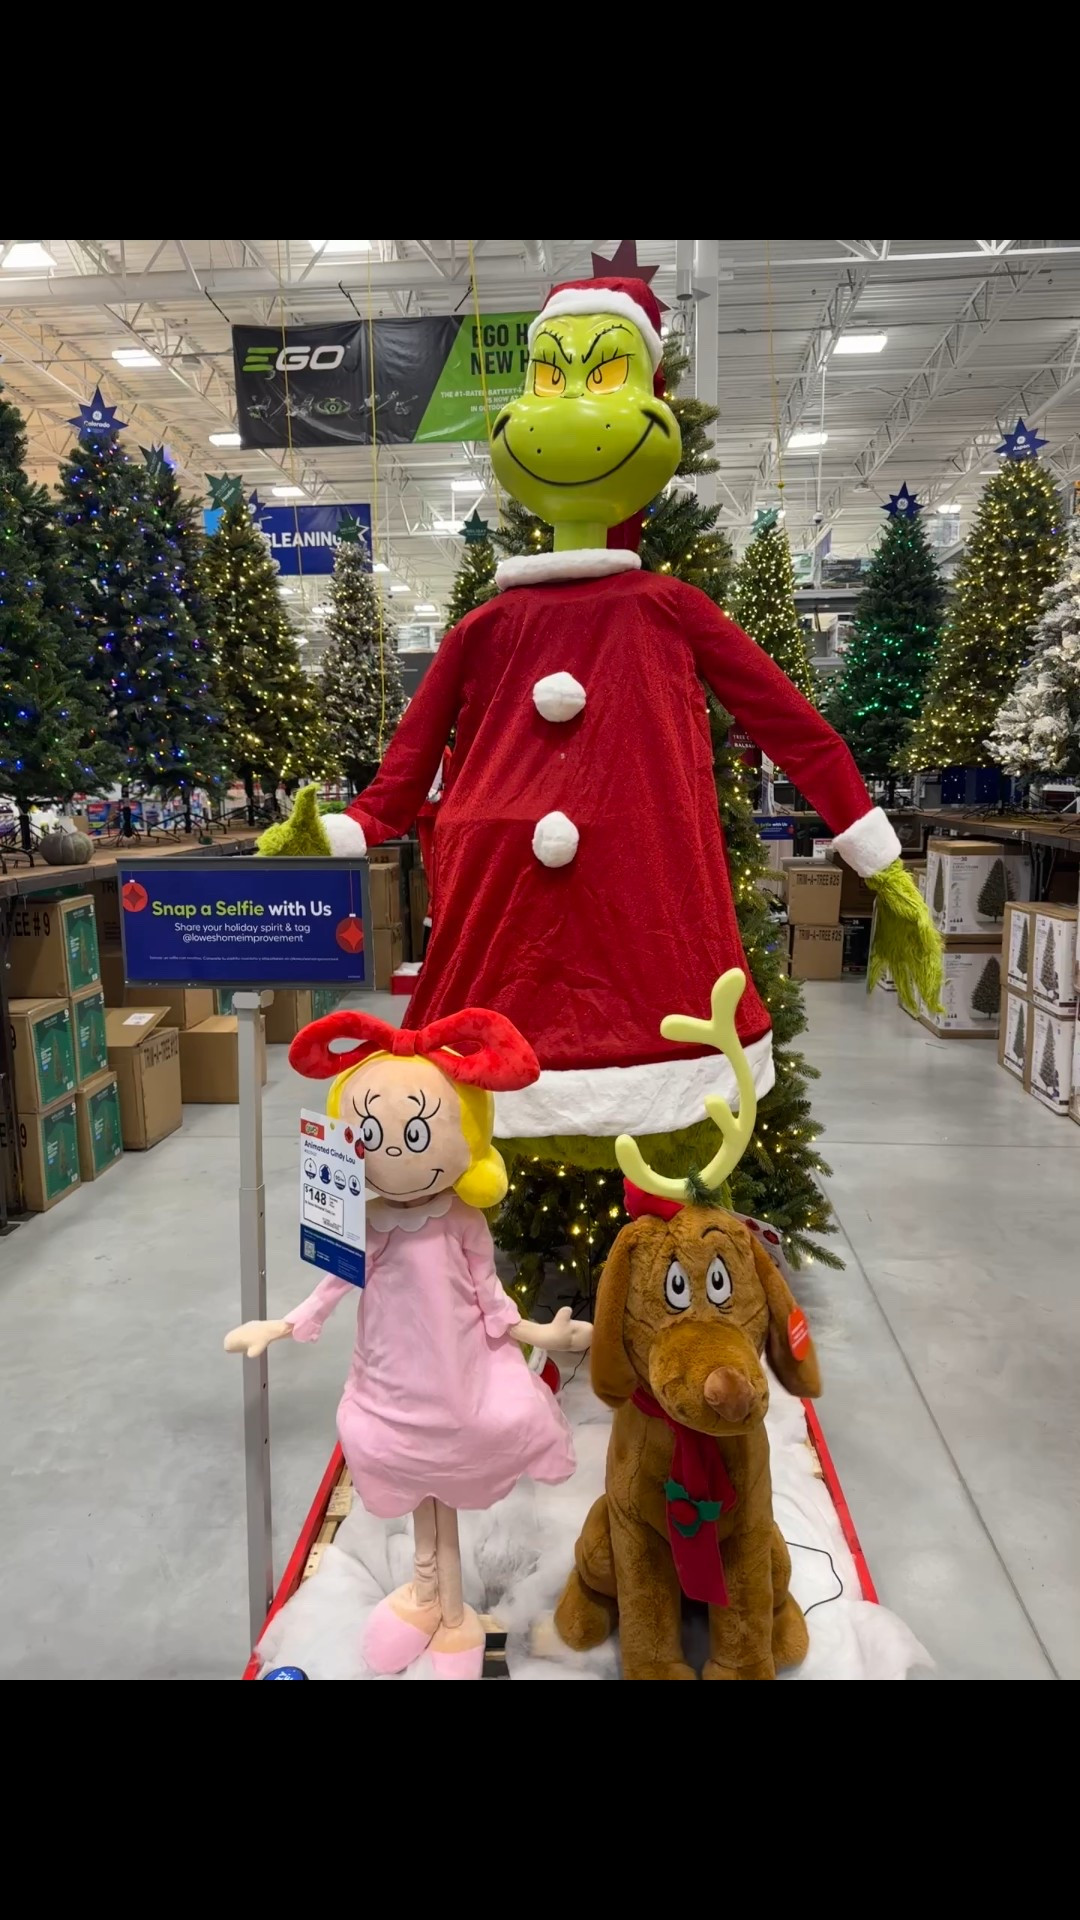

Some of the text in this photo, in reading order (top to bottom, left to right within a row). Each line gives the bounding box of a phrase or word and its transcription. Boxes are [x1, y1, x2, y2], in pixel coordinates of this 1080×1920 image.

[471, 322, 528, 348] EGO H
[242, 344, 345, 372] EGO
[470, 349, 530, 375] NEW H
[441, 391, 453, 399] THE
[454, 389, 486, 397] #1-RATE
[152, 900, 332, 919] Snap a Selfie with Us
[174, 922, 310, 934] Share your holiday spirit & tag
[182, 932, 304, 944] @loweshomeimprovement
[304, 1140, 330, 1154] Animated
[330, 1148, 345, 1162] Cindy
[345, 1154, 356, 1164] Lou
[305, 1185, 327, 1206] $148
